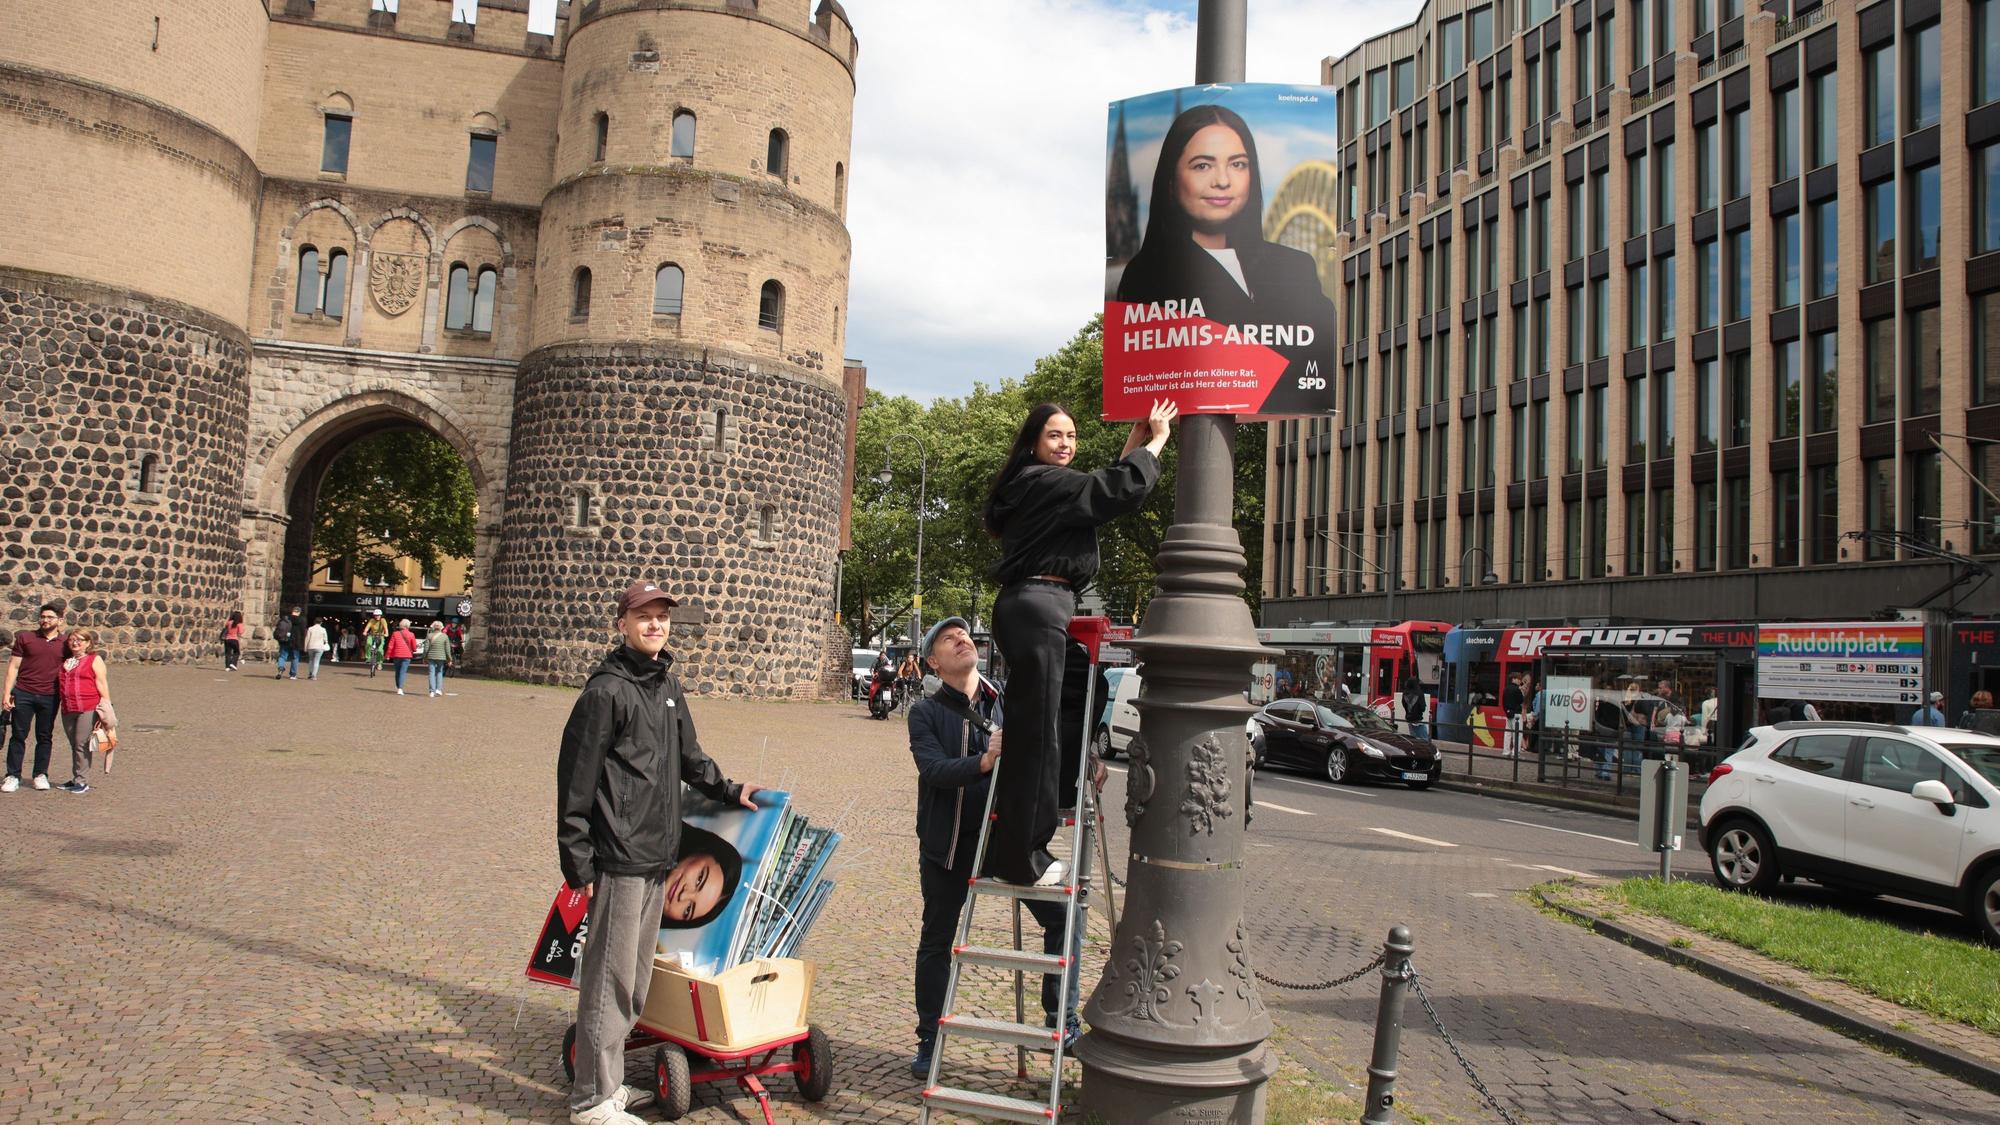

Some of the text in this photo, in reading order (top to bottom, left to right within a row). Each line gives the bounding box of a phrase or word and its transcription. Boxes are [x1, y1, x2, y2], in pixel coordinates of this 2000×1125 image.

[1123, 297, 1206, 325] MARIA
[1123, 324, 1315, 352] HELMIS-AREND
[1136, 374, 1154, 382] Euch
[1155, 371, 1182, 380] wieder
[1183, 370, 1192, 378] in
[1193, 369, 1208, 377] den
[1210, 369, 1238, 377] Kölner
[1240, 369, 1256, 377] Rat.
[1123, 379, 1258, 394] Denn Kultur ist das Herz der Stadt!
[1298, 377, 1326, 390] SPD
[356, 597, 373, 606] Café
[386, 597, 430, 609] BARISTA
[1465, 636, 1495, 645] skechers.de
[1701, 632, 1725, 643] THE
[1958, 630, 1995, 644] THE
[1776, 631, 1899, 657] Rudolfplatz
[1549, 694, 1571, 707] KVB
[545, 939, 559, 963] SPD
